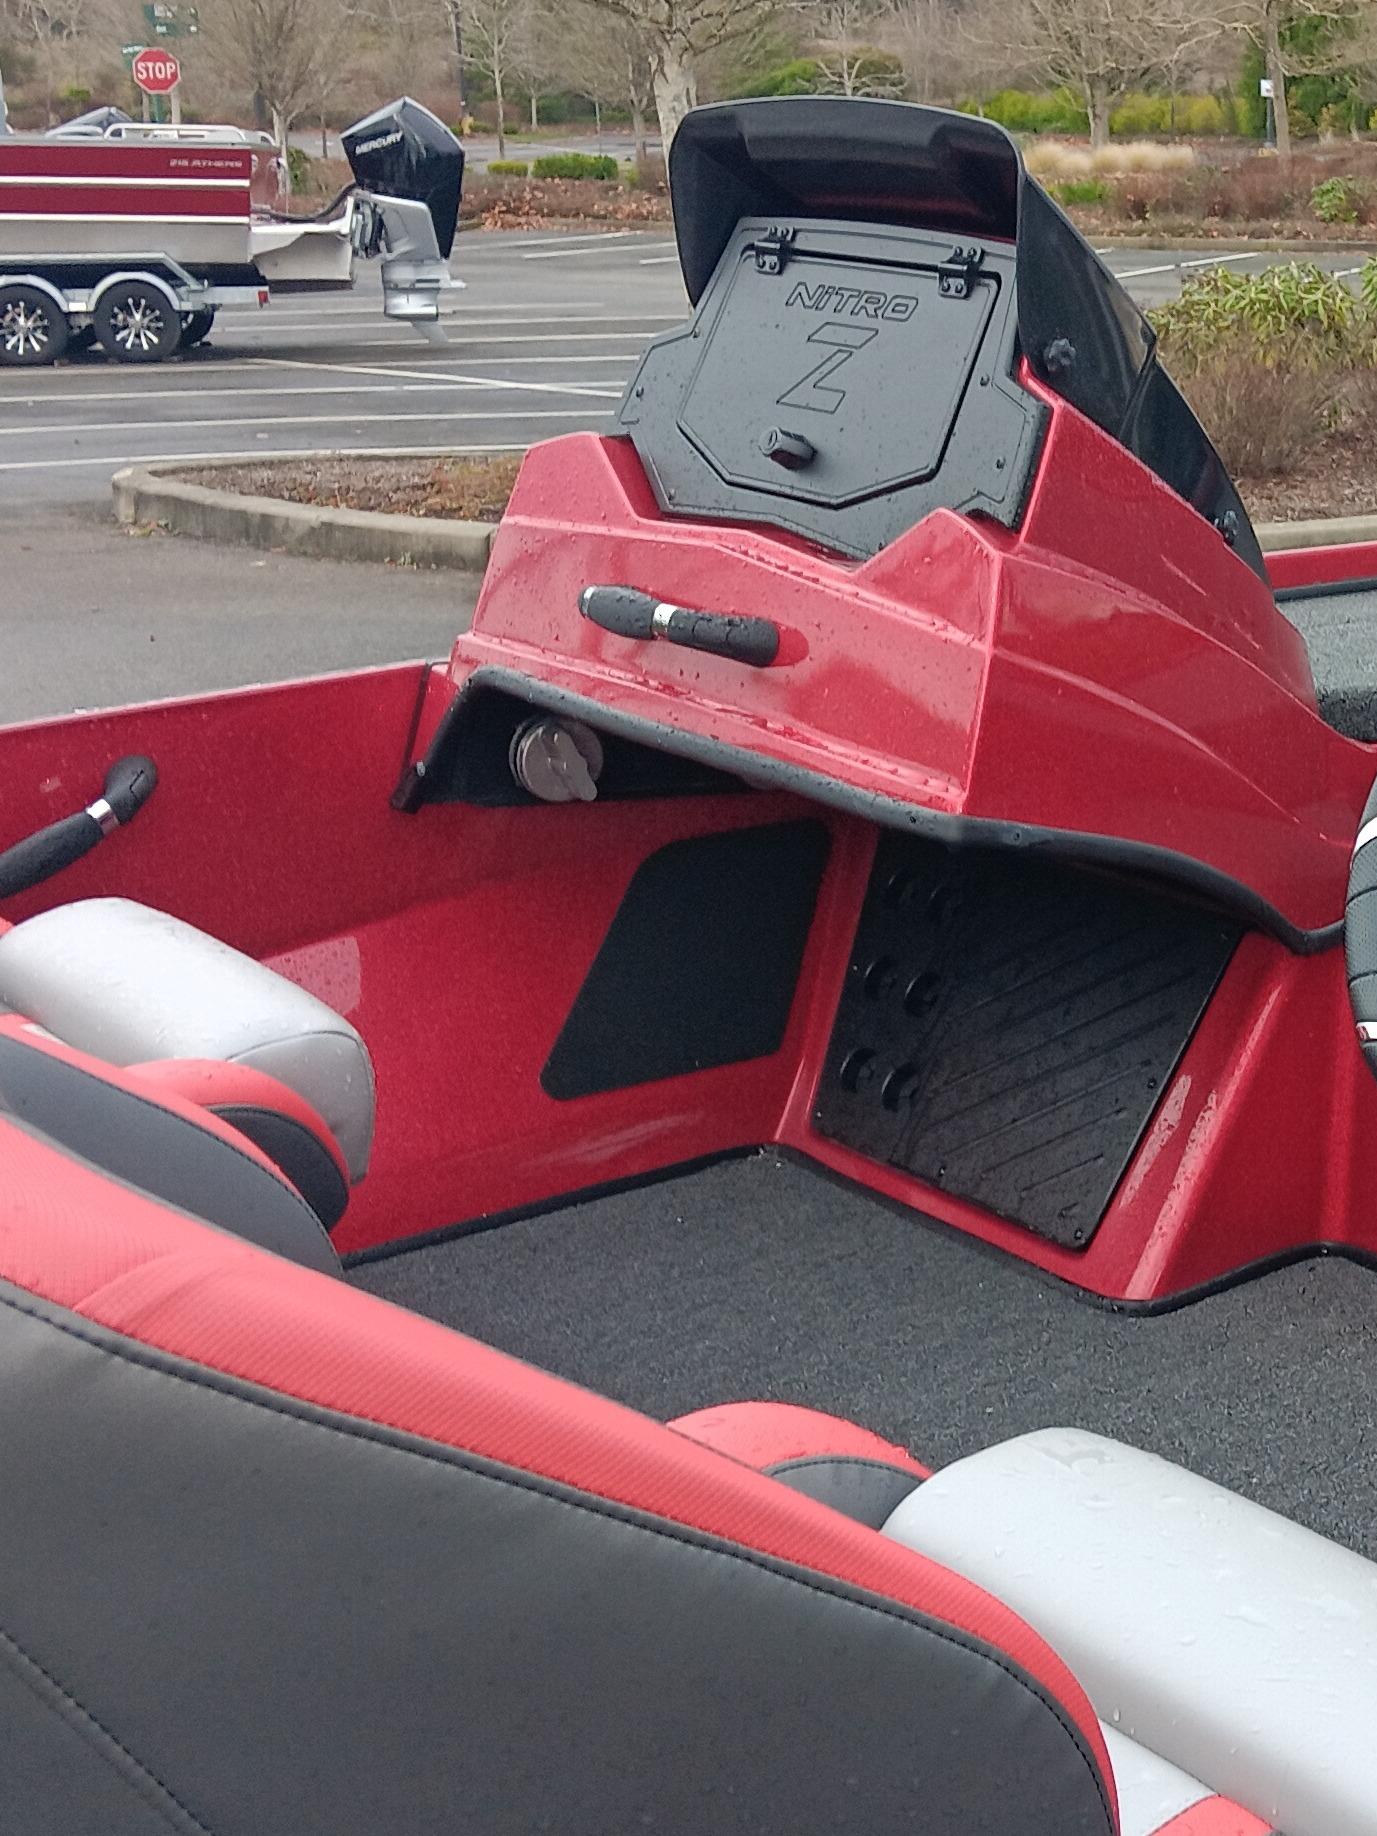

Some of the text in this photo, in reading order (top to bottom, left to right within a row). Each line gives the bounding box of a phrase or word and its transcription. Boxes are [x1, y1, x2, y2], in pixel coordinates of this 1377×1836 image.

[137, 61, 176, 80] STOP
[355, 130, 403, 156] MERCURY
[776, 321, 879, 415] Z
